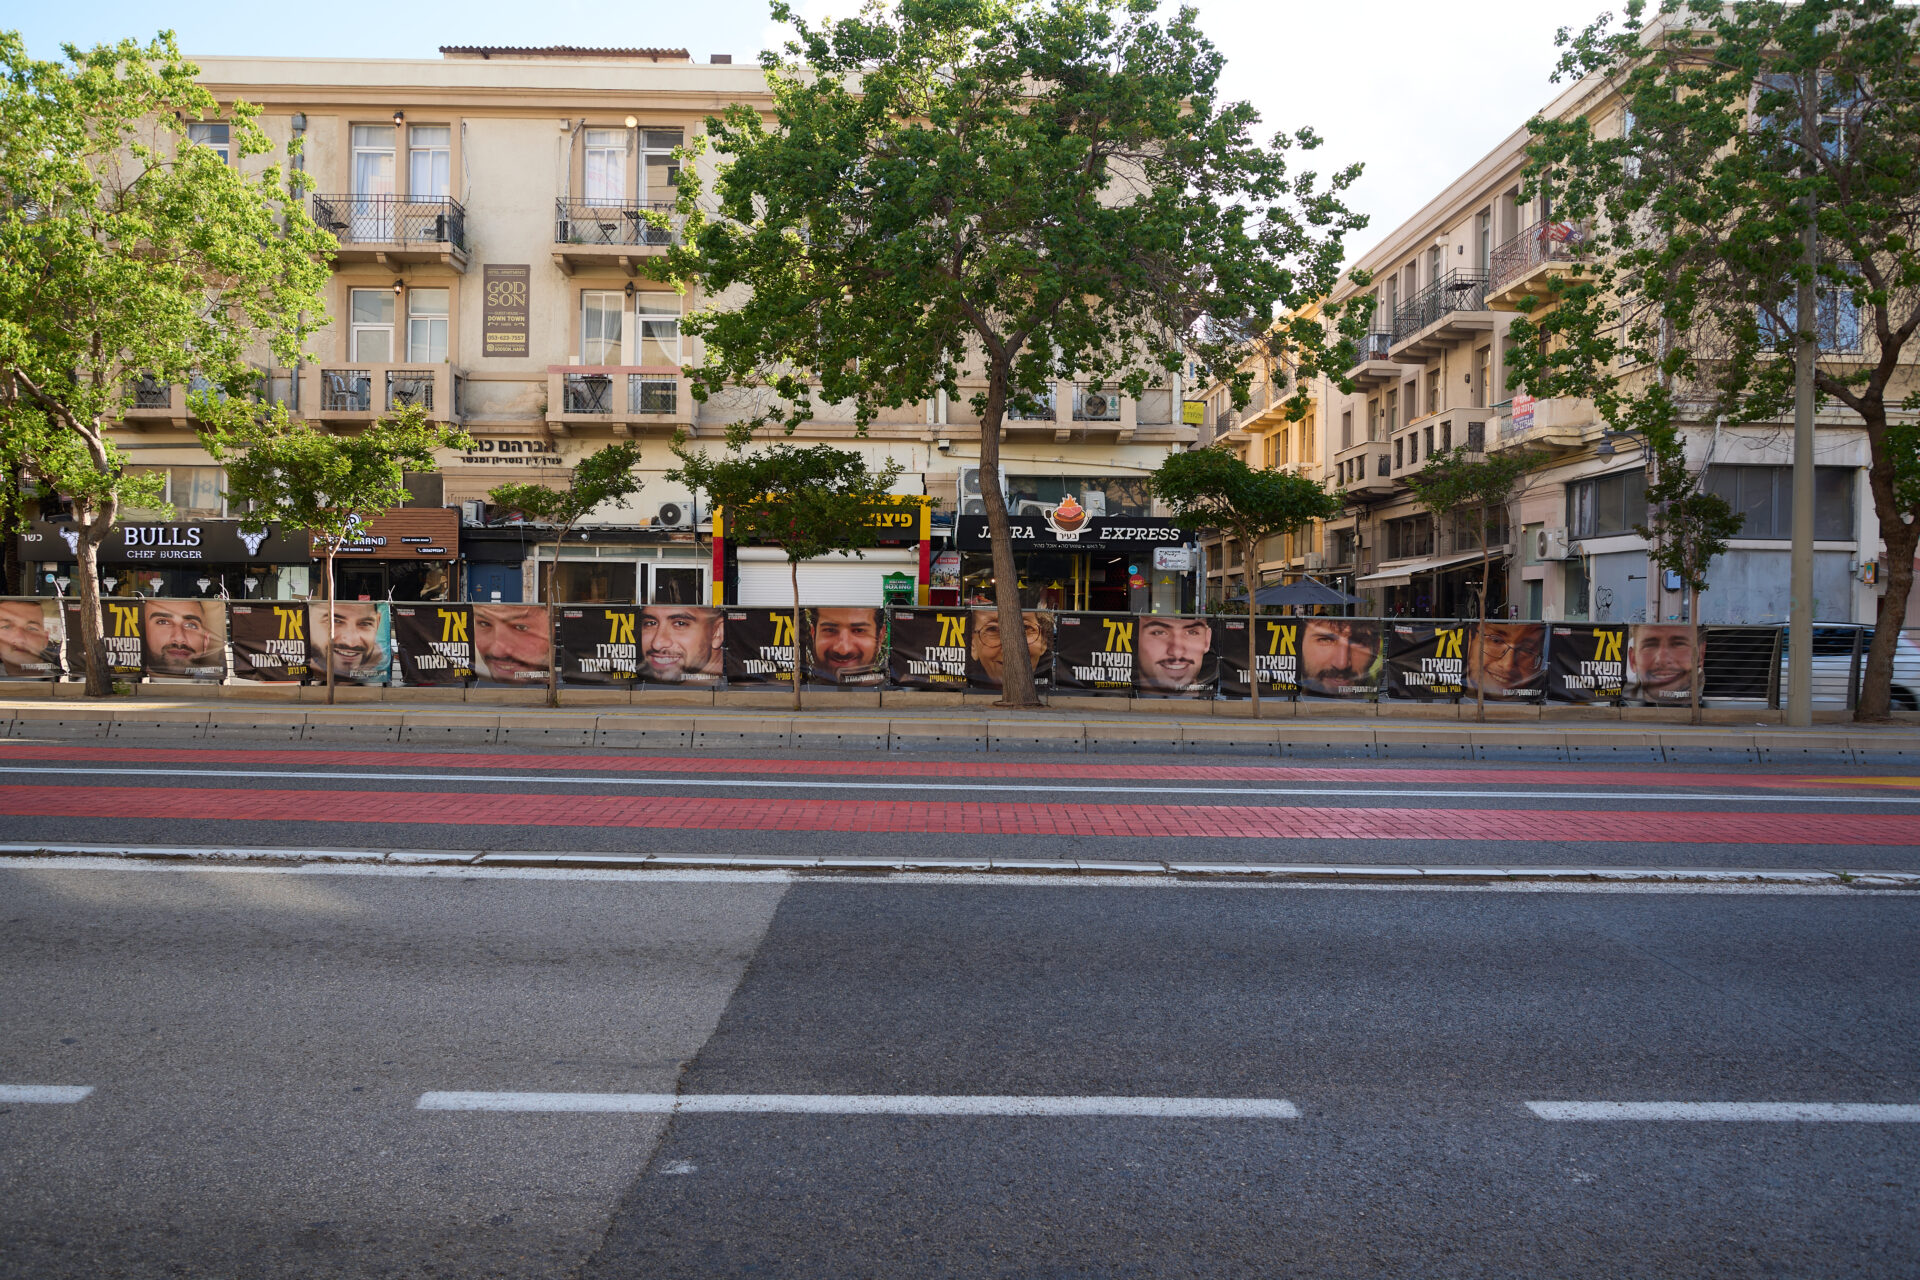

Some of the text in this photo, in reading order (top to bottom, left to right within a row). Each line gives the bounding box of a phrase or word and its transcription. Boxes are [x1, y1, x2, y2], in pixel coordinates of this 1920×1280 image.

[487, 281, 527, 294] GOD
[487, 294, 527, 307] SON
[498, 440, 560, 453] אברהם
[492, 456, 523, 465] נוטריון
[21, 533, 43, 543] כשר
[124, 527, 202, 547] BULLS
[1059, 532, 1077, 540] בעיר
[1099, 527, 1181, 541] EXPRESS
[127, 550, 202, 559] CHEF BURGER
[109, 603, 140, 637] אל
[273, 606, 304, 640] אל
[438, 608, 469, 642] אל
[605, 610, 636, 643] אל
[769, 612, 801, 646] אל
[936, 613, 966, 648] אל
[1103, 618, 1133, 653] אל
[1267, 621, 1297, 655] אל
[1435, 628, 1464, 658] אל
[1593, 628, 1623, 661] אל
[265, 639, 305, 655] תשאירו
[428, 642, 470, 656] תשאירו
[596, 643, 636, 658] תשאירו
[925, 647, 966, 662] תשאירו
[118, 652, 142, 667] אותי
[249, 653, 282, 668] מאחור
[414, 654, 448, 670] מאחור
[578, 658, 637, 673] אותי מאחור
[743, 659, 777, 674] מאחור
[1091, 652, 1132, 667] תשאירו
[1255, 655, 1296, 670] תשאירו
[1421, 658, 1462, 673] תשאירו
[907, 660, 966, 676] אותי מאחור
[1072, 666, 1132, 682] אותי מאחור
[1580, 661, 1622, 675] תשאירו
[1273, 670, 1296, 684] אותי
[1402, 671, 1462, 686] אותי מאחור
[1562, 675, 1595, 689] מאחור
